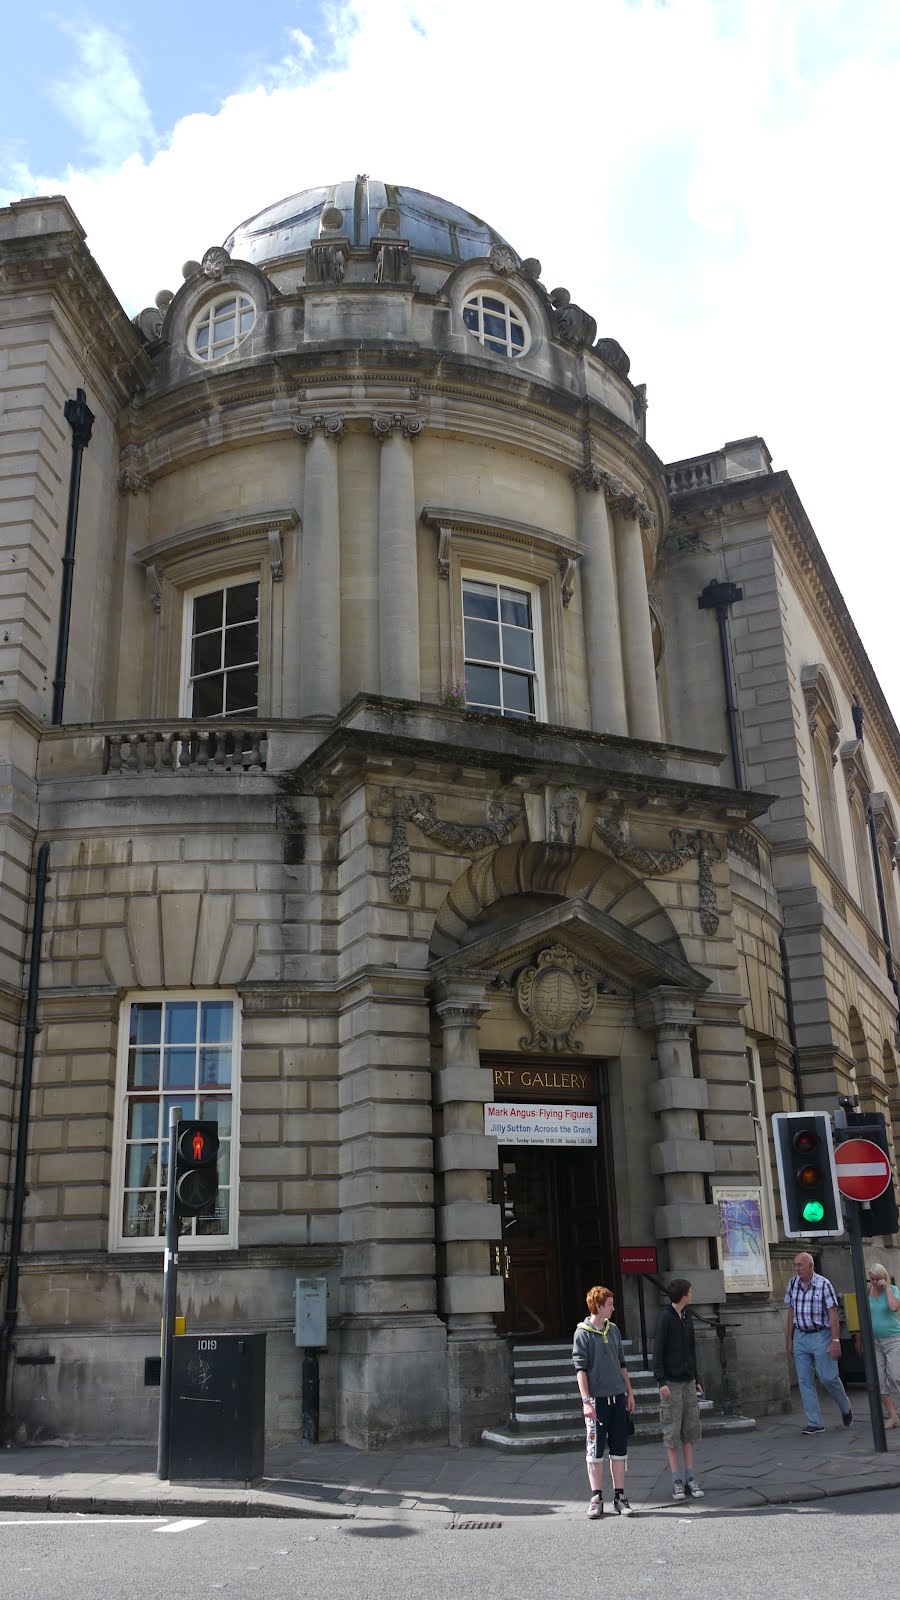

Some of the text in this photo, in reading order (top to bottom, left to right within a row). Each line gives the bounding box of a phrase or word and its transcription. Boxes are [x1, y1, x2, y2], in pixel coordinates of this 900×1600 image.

[493, 1070, 588, 1089] RT GALLERY
[488, 1107, 508, 1117] Mark
[539, 1108, 563, 1120] Flying
[565, 1109, 594, 1120] Figures
[490, 1124, 506, 1133] Jilly
[534, 1125, 558, 1133] Across
[560, 1125, 571, 1133] the
[573, 1126, 592, 1134] Grain
[198, 1339, 217, 1351] 1019
